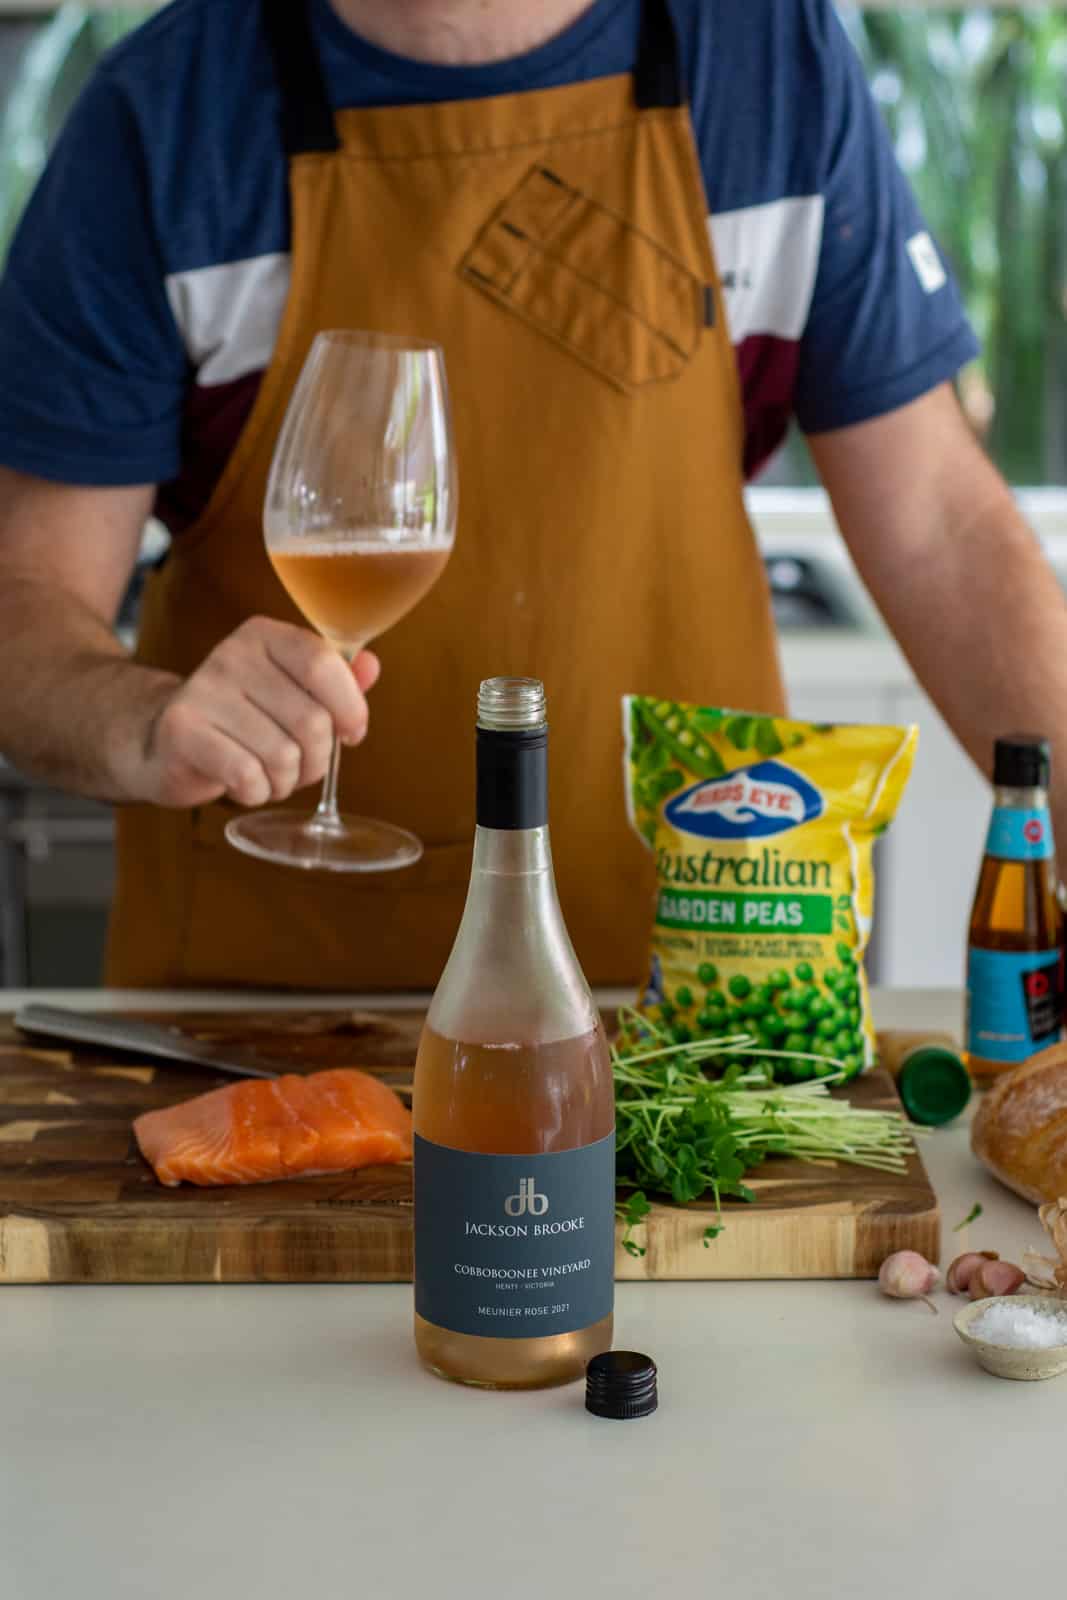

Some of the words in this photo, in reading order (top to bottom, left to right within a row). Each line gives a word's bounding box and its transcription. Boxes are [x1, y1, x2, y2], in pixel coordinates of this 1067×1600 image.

[749, 788, 791, 810] EYE
[743, 901, 804, 926] PEAS
[465, 1221, 528, 1237] JACKSON
[534, 1216, 585, 1236] BROOKE
[454, 1263, 539, 1279] COBBOBOONEE
[542, 1258, 591, 1277] VINEYARD
[478, 1306, 522, 1317] MEUNIER
[524, 1305, 549, 1316] ROSE
[551, 1303, 570, 1314] 2021
